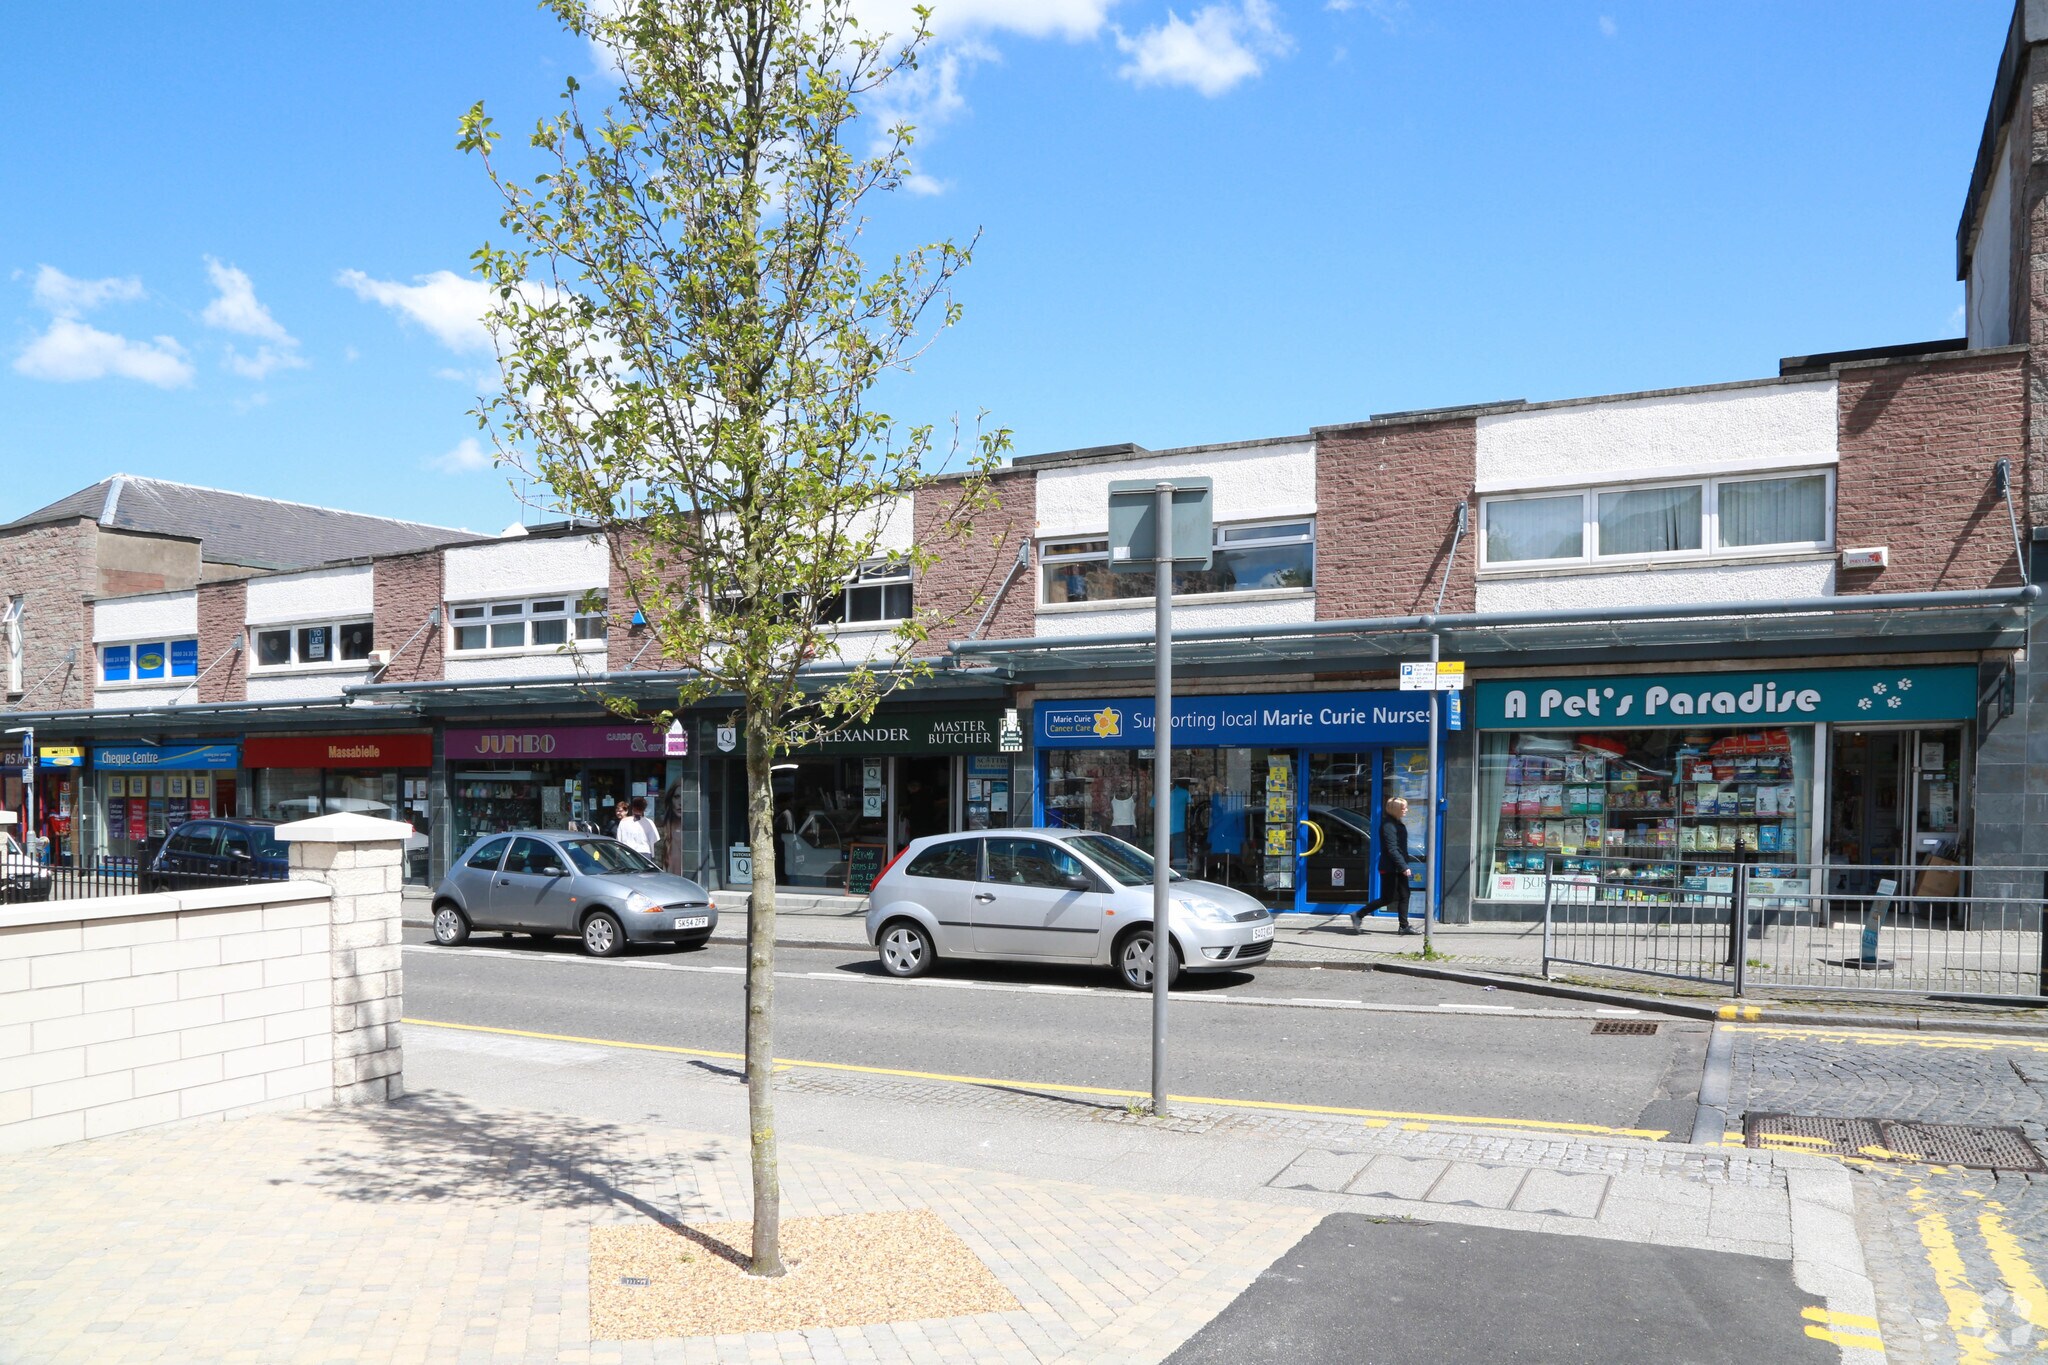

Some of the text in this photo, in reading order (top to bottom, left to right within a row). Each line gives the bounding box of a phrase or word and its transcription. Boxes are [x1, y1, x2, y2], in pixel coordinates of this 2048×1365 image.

[1504, 681, 1821, 718] A Pet's Paradise
[1053, 715, 1073, 723] Marie
[1133, 711, 1216, 731] Suorting
[1222, 710, 1257, 726] local
[1263, 709, 1313, 726] Marie
[1319, 707, 1366, 725] Curie
[933, 720, 986, 732] MASTER
[1075, 724, 1091, 732] Care
[606, 733, 632, 741] CARDS
[928, 732, 992, 744] BUTCHER
[475, 734, 556, 754] JUMBO
[328, 744, 380, 758] Massabielle
[5, 753, 16, 765] RS
[101, 751, 159, 766] Cheque Centre
[738, 859, 750, 875] Q
[1522, 876, 1567, 890] BURS
[677, 918, 694, 928] SK54
